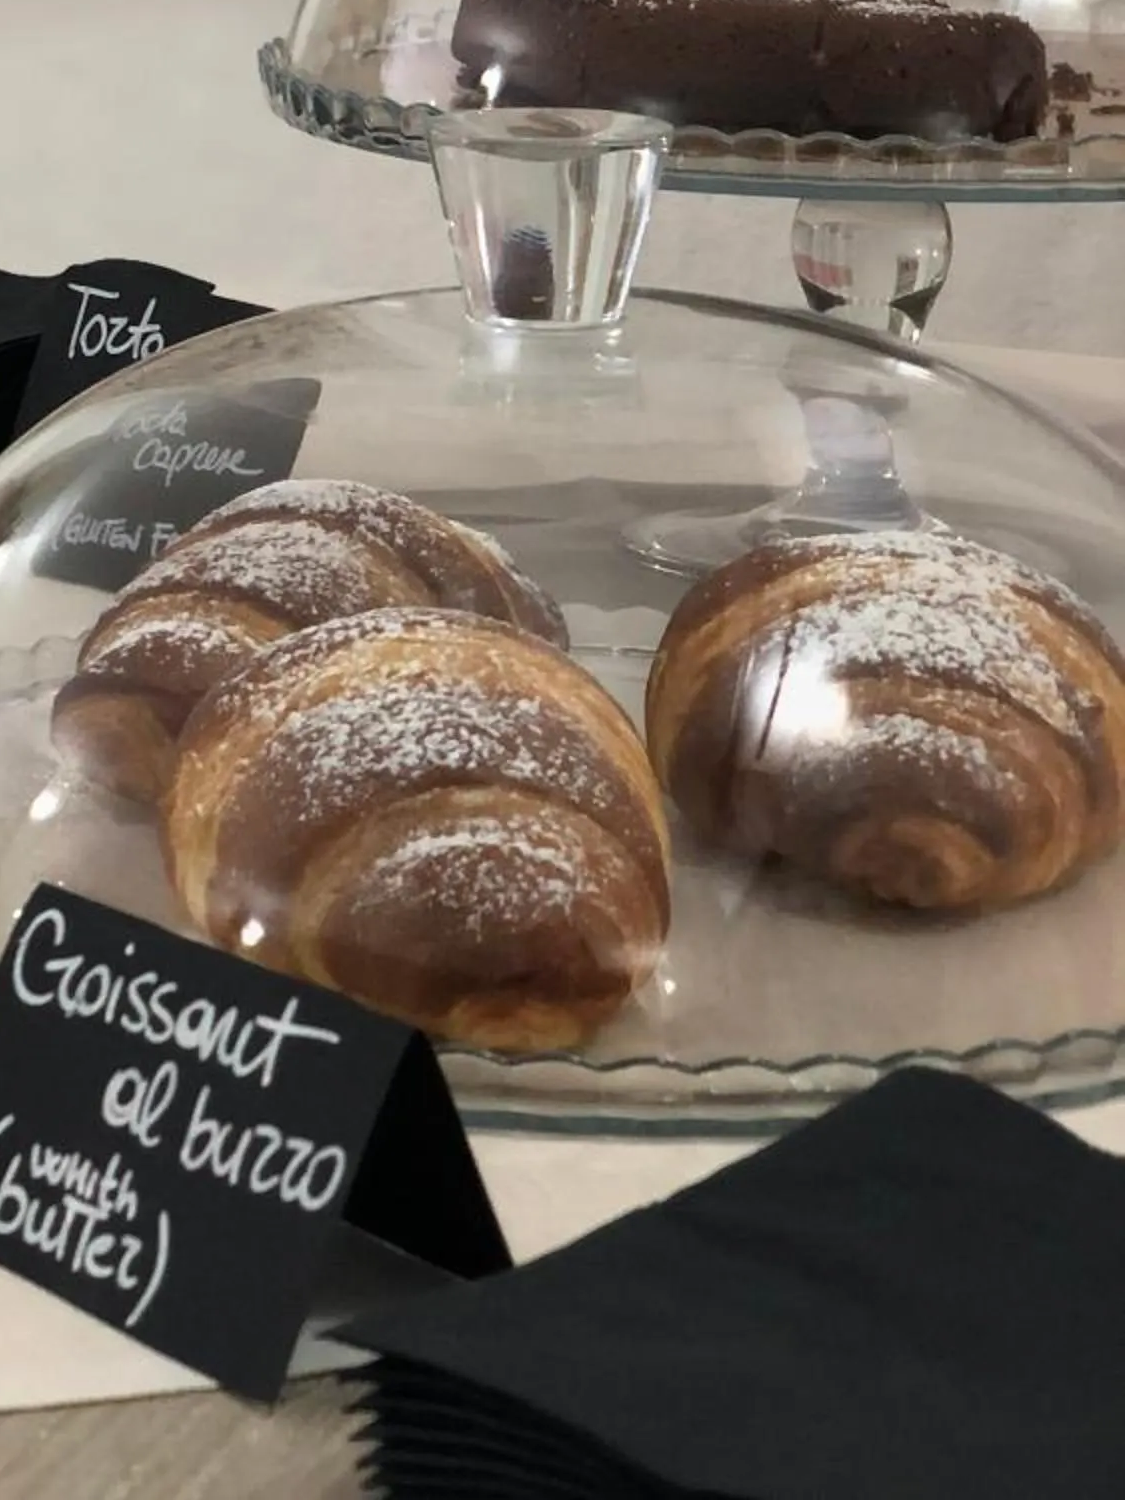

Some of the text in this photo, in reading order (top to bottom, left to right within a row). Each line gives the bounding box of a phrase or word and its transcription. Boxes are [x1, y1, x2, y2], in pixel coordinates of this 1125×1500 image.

[67, 282, 165, 360] Torta
[12, 907, 341, 1089] Croissant
[101, 1060, 179, 1148] al
